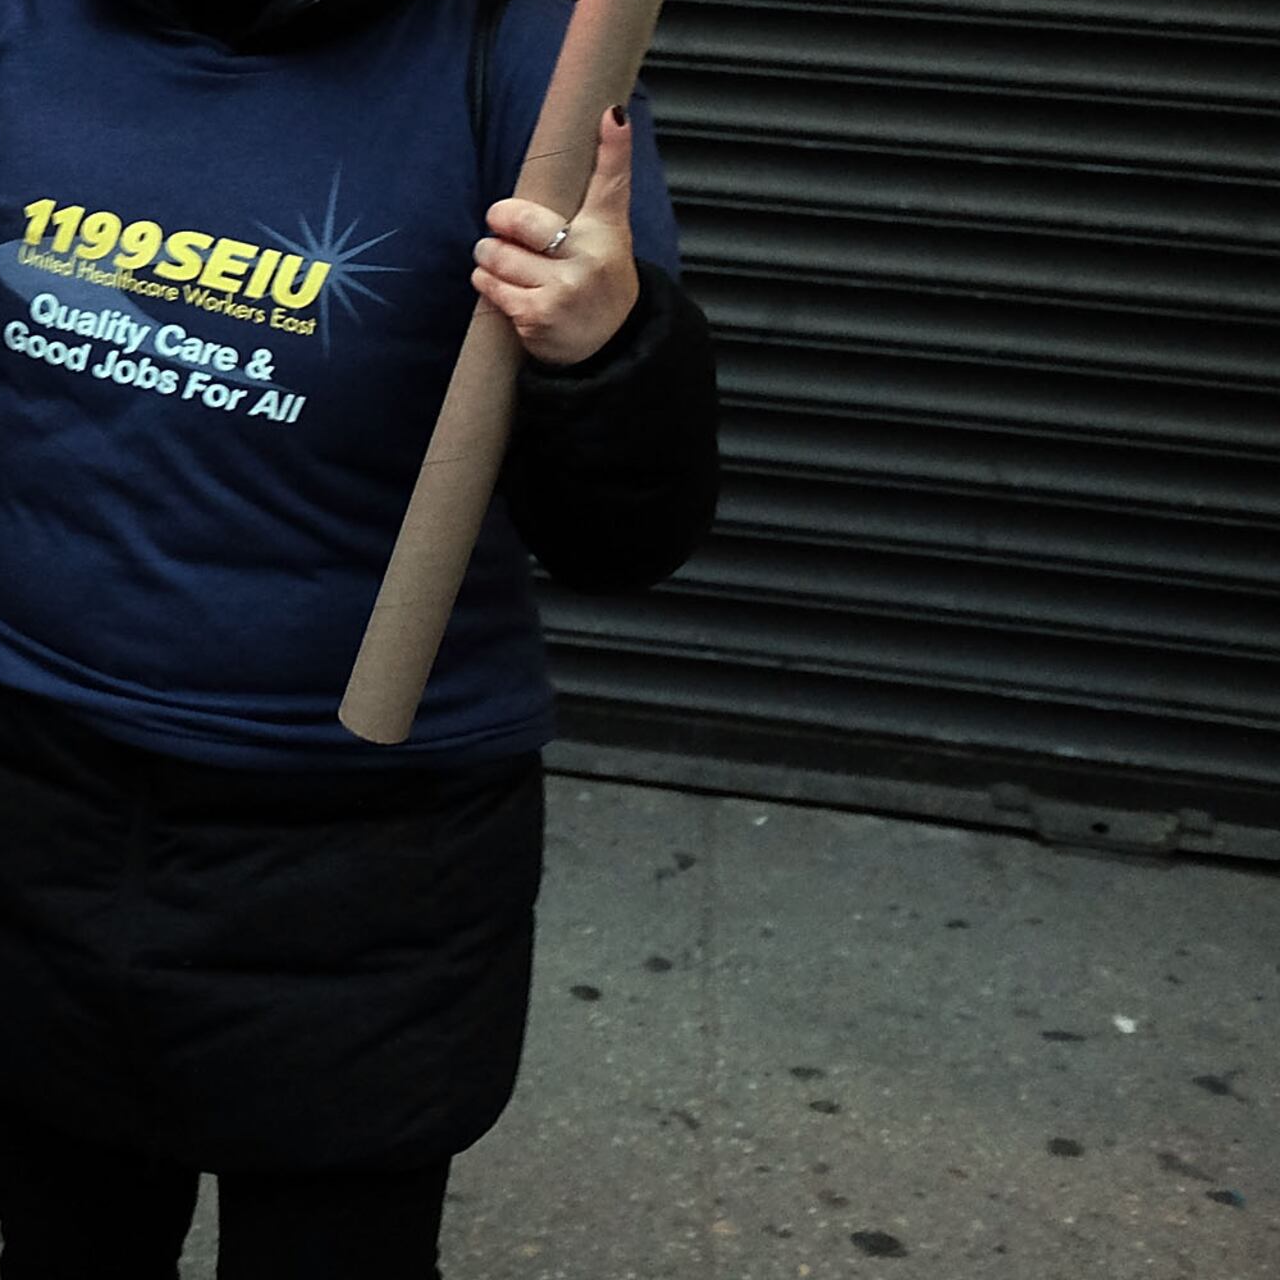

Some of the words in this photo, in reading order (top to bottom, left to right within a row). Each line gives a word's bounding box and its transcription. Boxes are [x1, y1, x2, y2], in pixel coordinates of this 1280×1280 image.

[17, 245, 77, 277] United
[78, 260, 179, 301] Healthcare
[183, 283, 266, 324] Workers
[269, 306, 317, 336] East
[23, 198, 332, 309] 1199SEIU
[3, 320, 92, 372] Good
[91, 349, 180, 394] Jobs
[181, 372, 248, 411] For
[247, 389, 307, 423] All
[30, 292, 151, 354] Quality
[153, 324, 240, 371] Care
[244, 348, 276, 381] &
